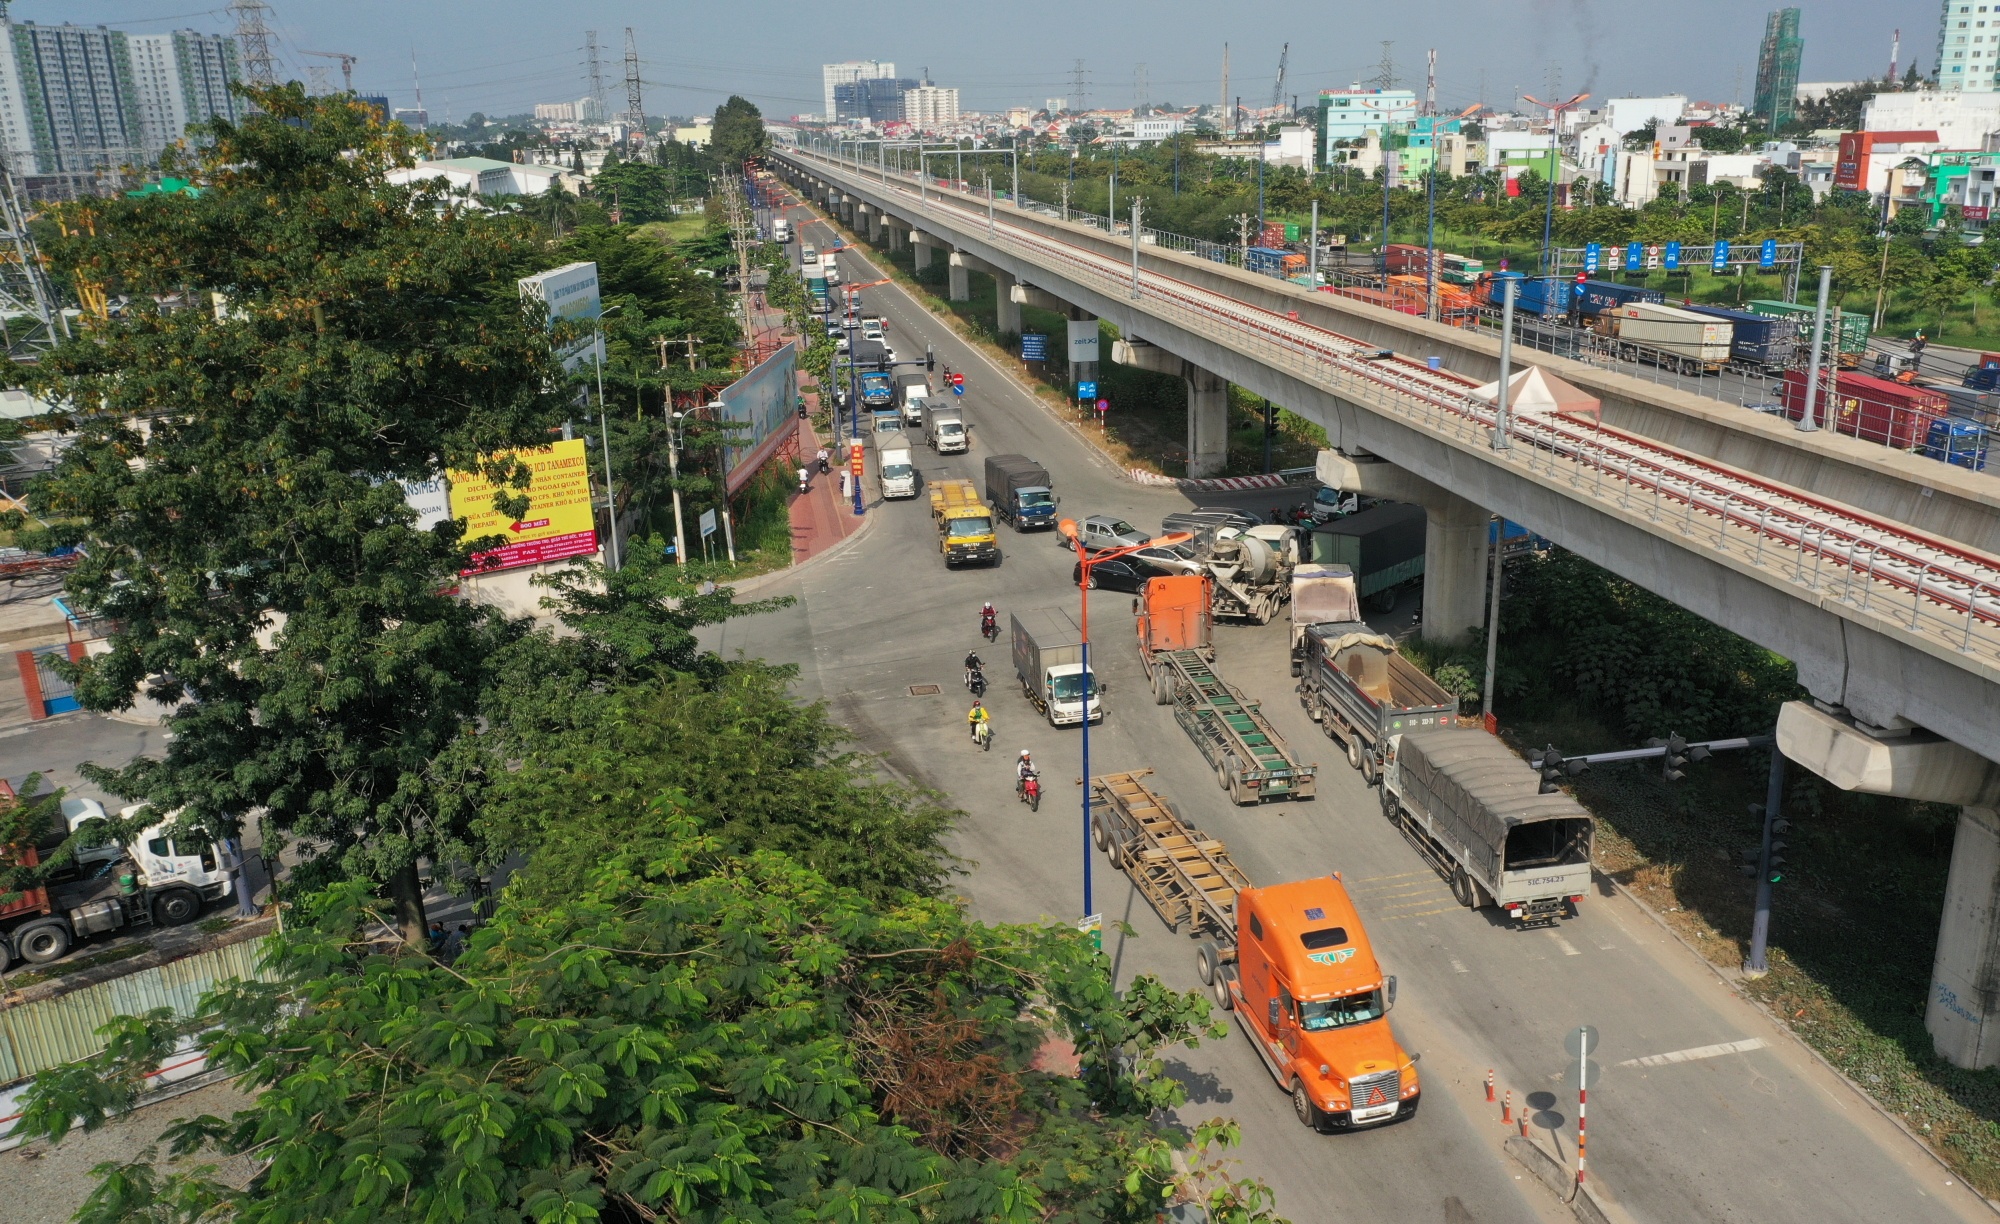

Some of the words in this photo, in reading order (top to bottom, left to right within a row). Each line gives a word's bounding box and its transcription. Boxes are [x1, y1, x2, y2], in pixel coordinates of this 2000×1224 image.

[534, 461, 546, 473] ICD
[547, 457, 585, 470] TANAMEXCO
[552, 471, 586, 482] CONTAINER
[560, 480, 581, 490] QUAN
[464, 493, 494, 503] (SERVIC
[421, 504, 442, 516] QUAN
[472, 520, 497, 529] (REPAIR)
